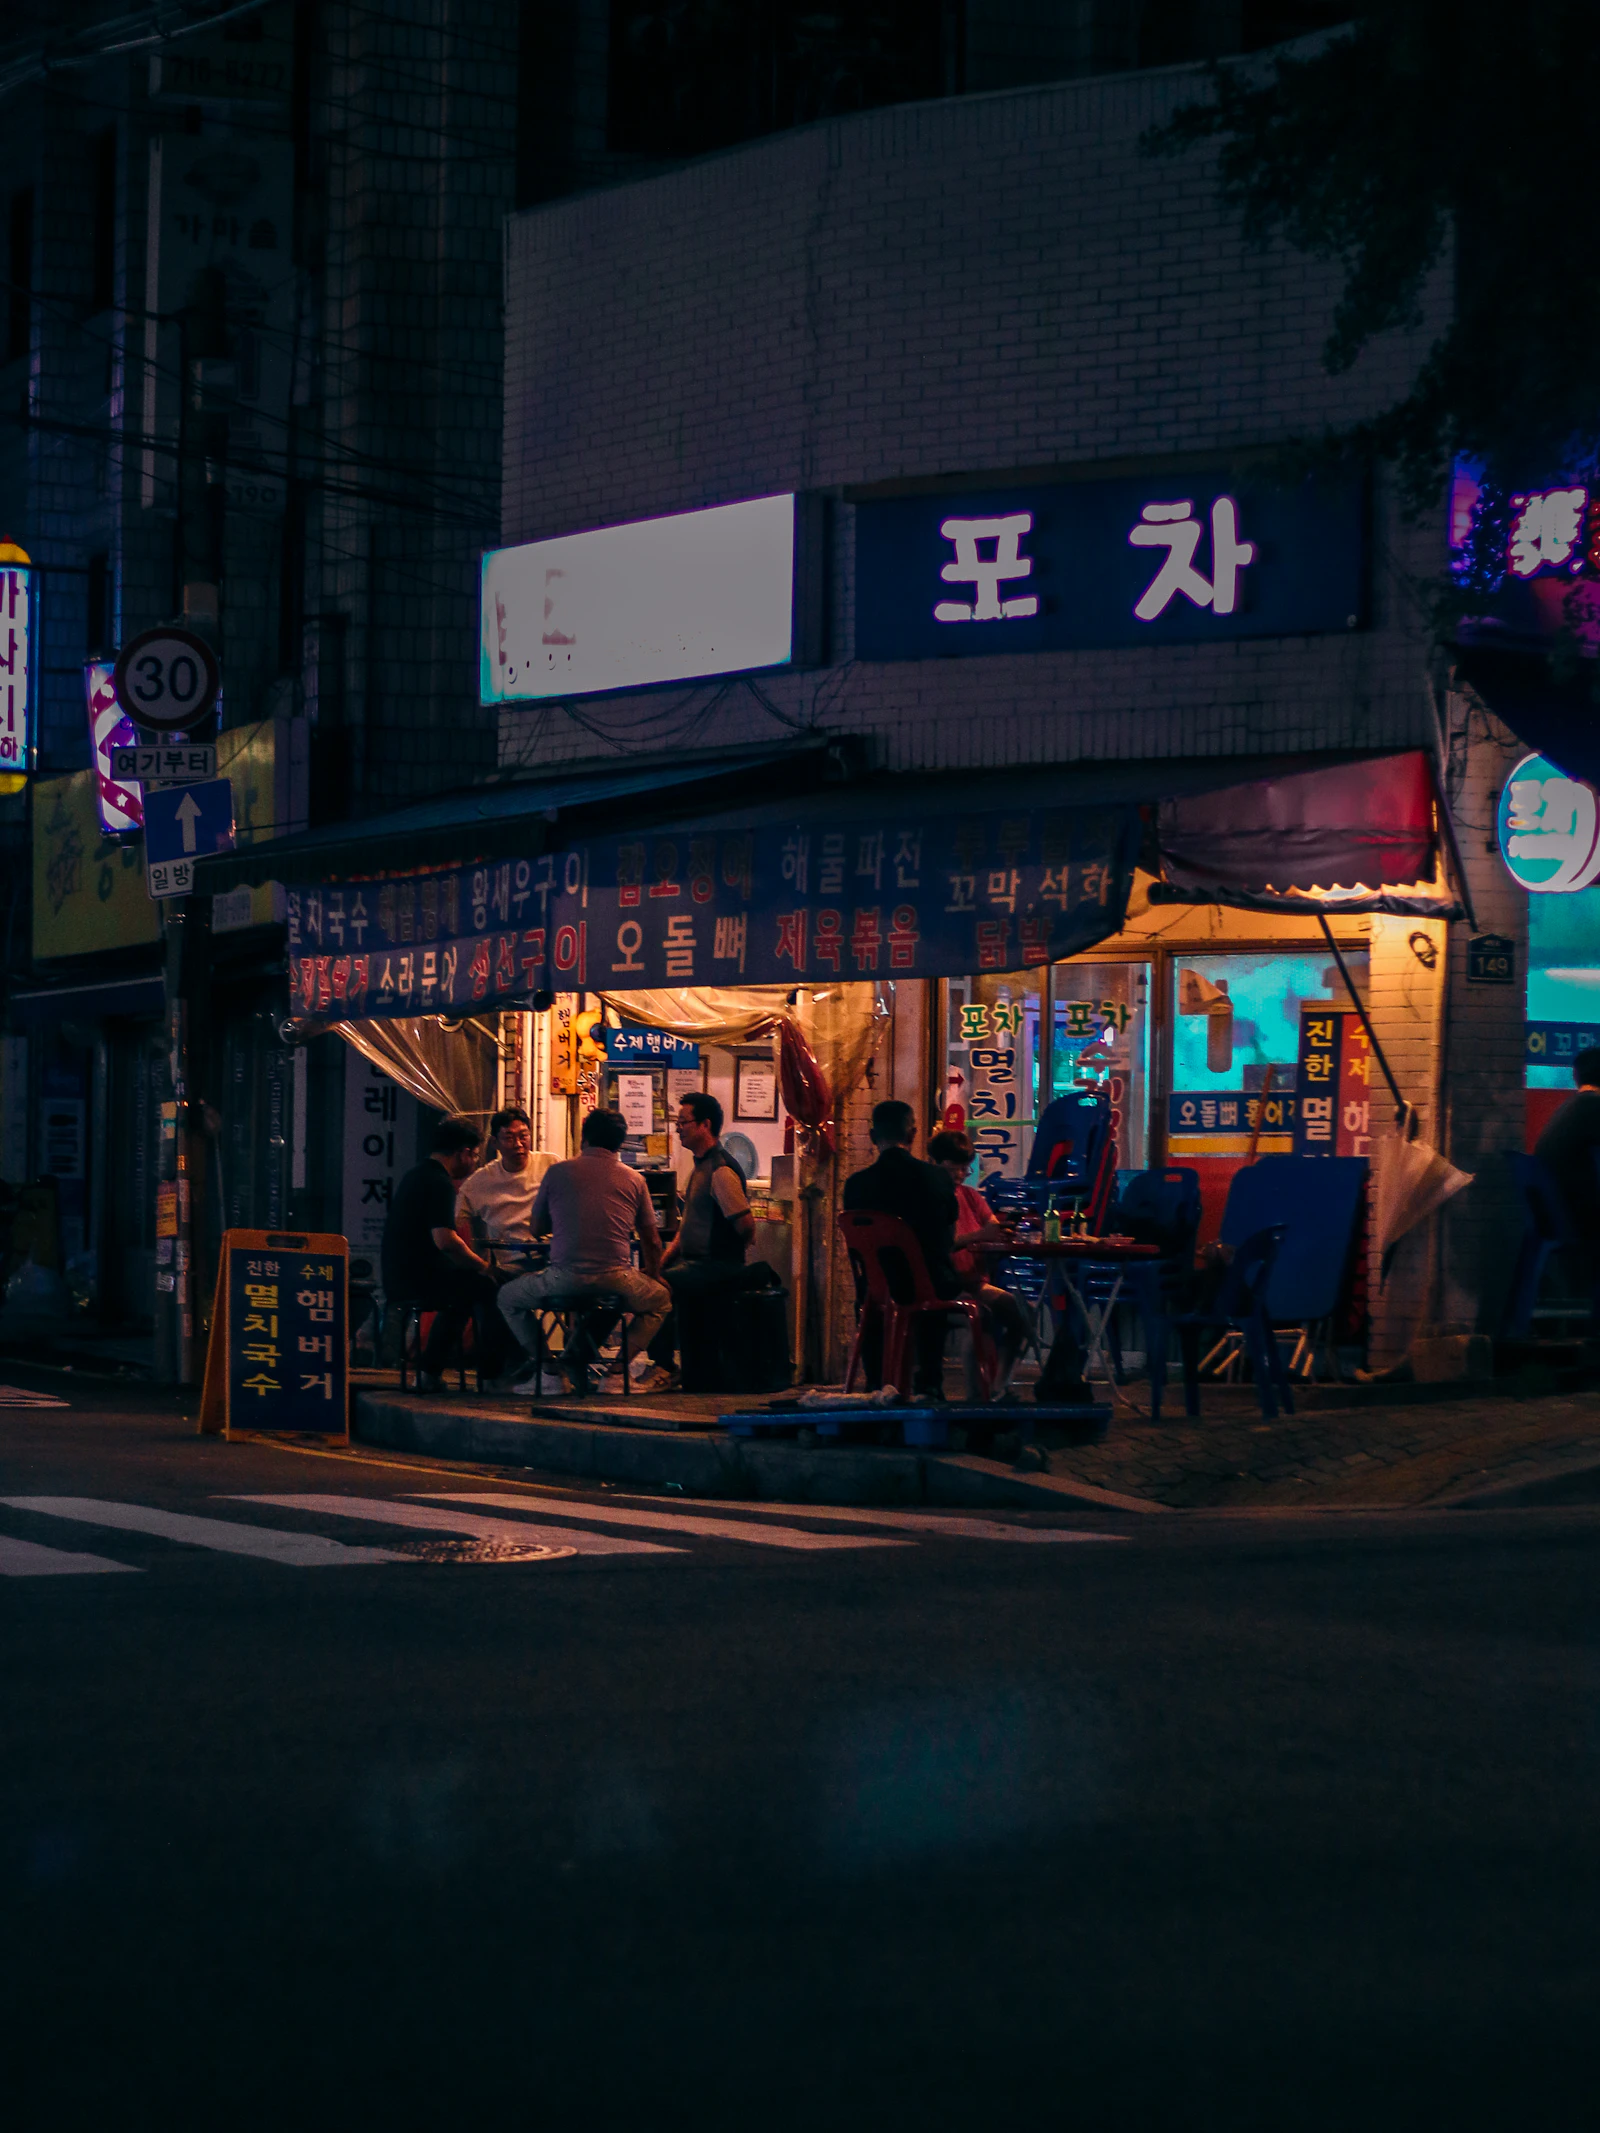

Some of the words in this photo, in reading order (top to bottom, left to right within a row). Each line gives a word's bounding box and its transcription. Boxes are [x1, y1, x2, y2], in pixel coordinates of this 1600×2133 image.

[933, 497, 1254, 622] 포차
[134, 655, 199, 702] 30
[118, 750, 209, 774] 여기부터
[151, 862, 191, 890] 일방
[471, 848, 588, 930] 왕새우구이
[781, 828, 924, 895] 해물파전
[468, 921, 586, 1000] 생선구이
[611, 911, 748, 977] 오돌뼈
[774, 904, 921, 972] 제육볶음
[975, 917, 1055, 968] 닭발
[1477, 956, 1508, 975] 149
[960, 1002, 1024, 1041] 포차
[1065, 1001, 1132, 1038] 포차
[613, 1031, 695, 1054] 수제햄버거
[1303, 1019, 1334, 1082] 진한
[970, 1049, 1017, 1186] 멸치국
[1178, 1099, 1239, 1128] 오돌뼈
[246, 1260, 281, 1278] 진한
[299, 1263, 334, 1282] 수제
[241, 1283, 283, 1397] 멸치국수
[295, 1290, 335, 1400] 햄버거
